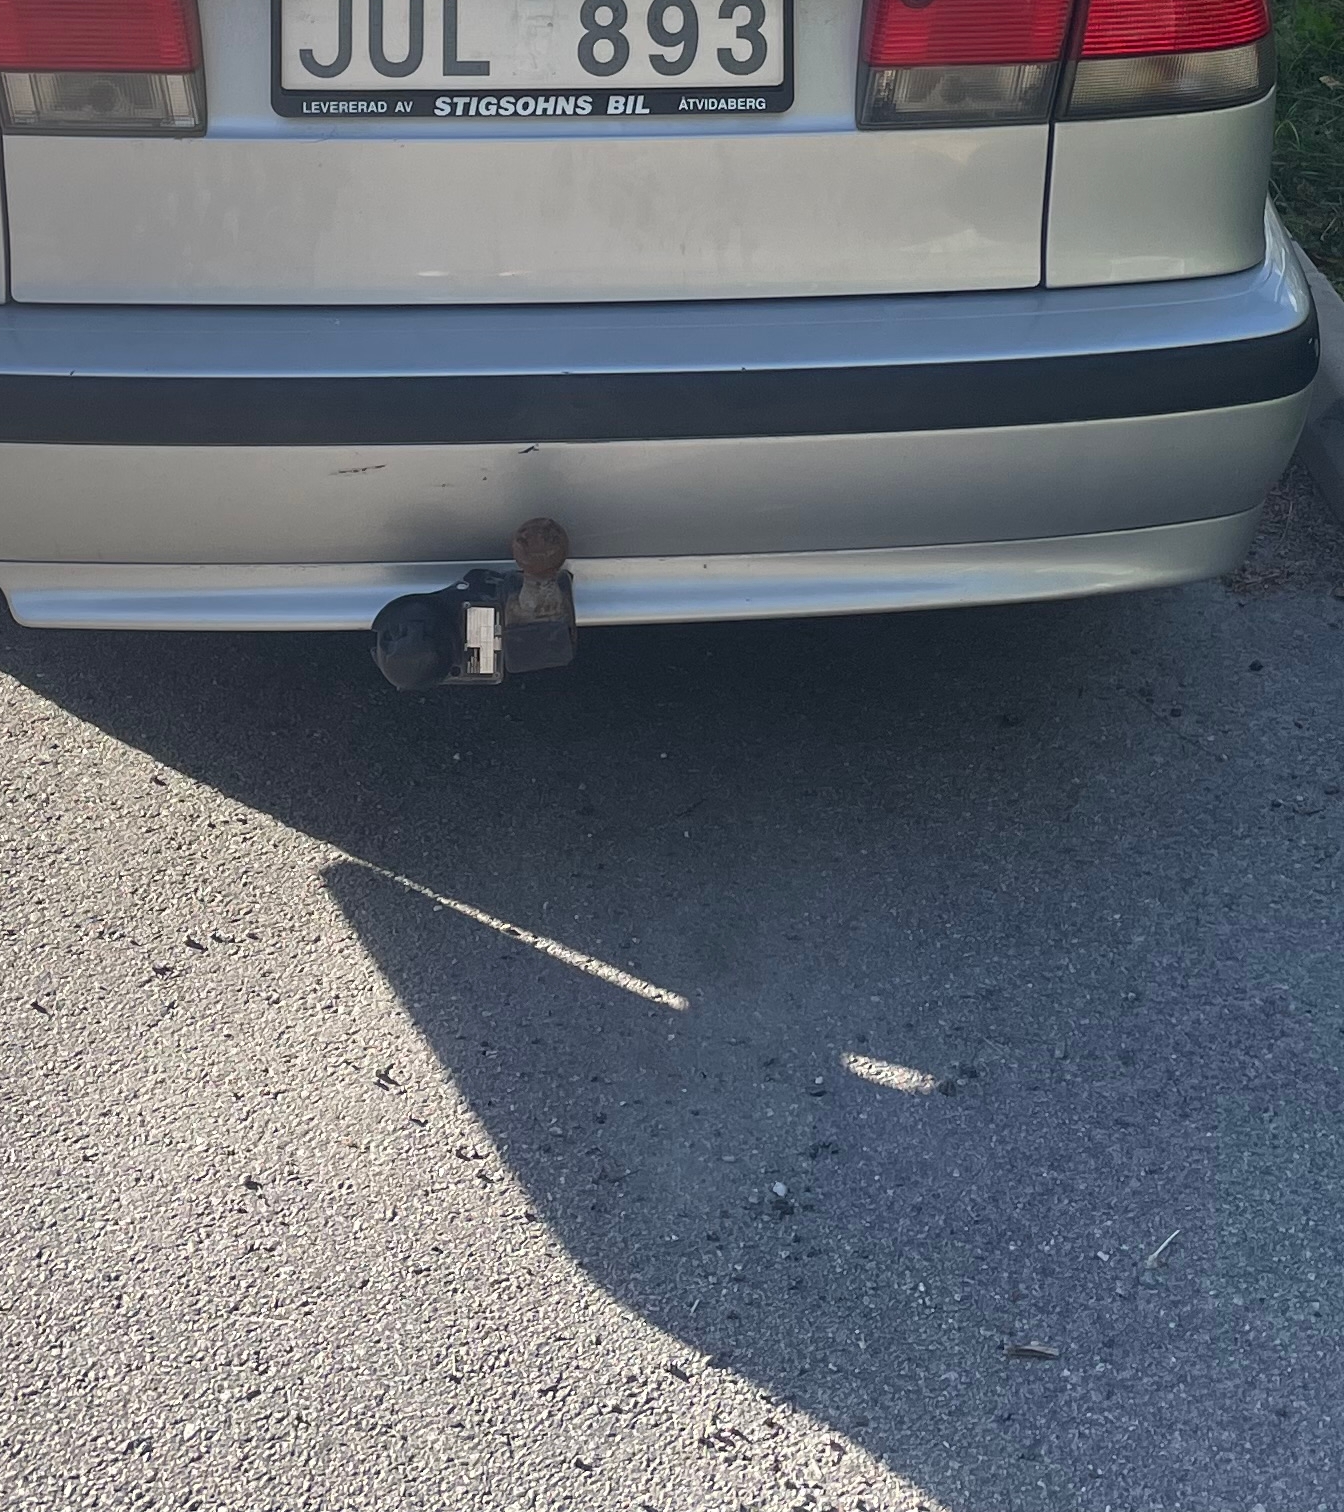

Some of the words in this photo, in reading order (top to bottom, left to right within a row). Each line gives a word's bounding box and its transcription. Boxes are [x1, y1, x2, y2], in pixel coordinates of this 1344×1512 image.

[302, 101, 388, 114] LEVERERAD
[394, 101, 414, 113] AV
[433, 95, 593, 117] STIGSOHNS
[606, 94, 651, 115] BIL
[678, 95, 767, 111] ÅTVIDABERG
